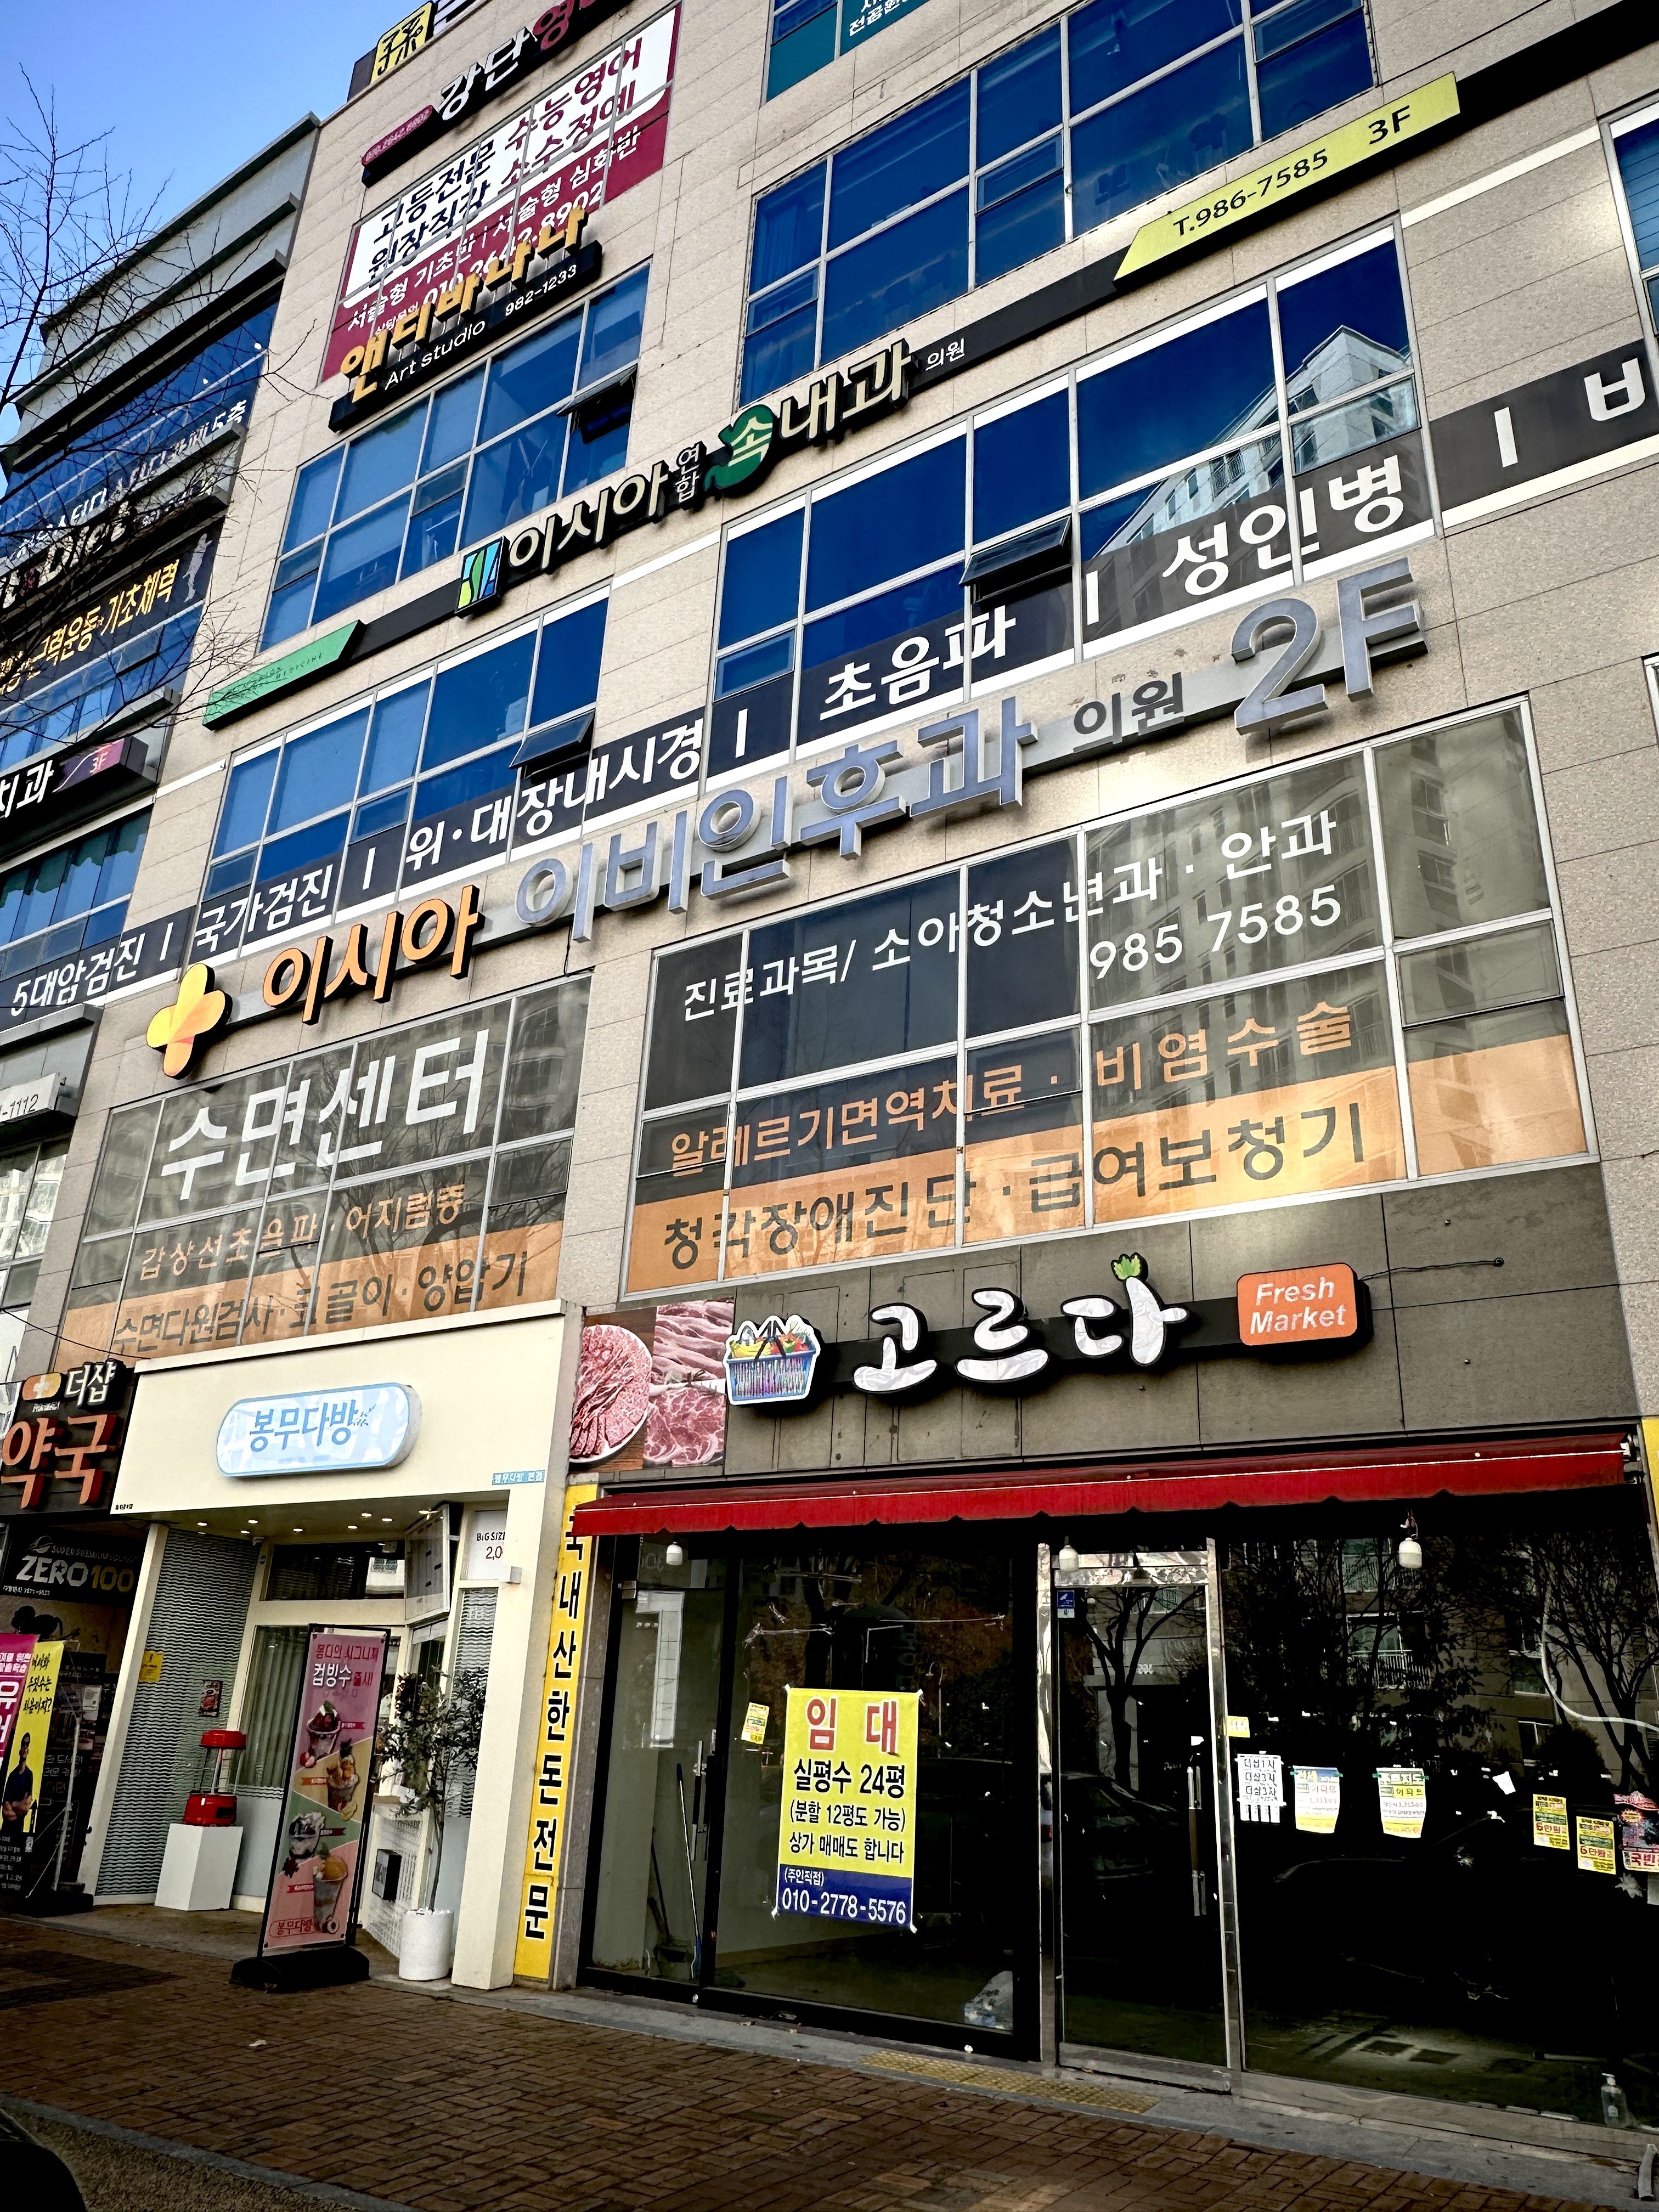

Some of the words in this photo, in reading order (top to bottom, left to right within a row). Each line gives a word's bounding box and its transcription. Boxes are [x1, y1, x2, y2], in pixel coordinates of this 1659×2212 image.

[441, 0, 597, 120] 강단영
[368, 180, 490, 287] 원장직강
[498, 80, 636, 195] 소수정예
[374, 139, 495, 243] 고등전문
[505, 37, 642, 150] 수능영어
[1173, 149, 1328, 236] T.986-7585
[1368, 105, 1410, 145] 3F
[348, 278, 408, 331] 서술형
[414, 233, 476, 287] 기초반
[493, 177, 561, 236] 서술형
[570, 125, 641, 190] 심화반
[340, 205, 585, 403] 앤디바나나
[386, 359, 415, 390] Art
[421, 321, 485, 368] studio
[505, 264, 576, 317] 982-1233
[509, 461, 668, 569] 이시아
[676, 441, 699, 503] 연합
[730, 341, 911, 467] 속내과
[927, 338, 965, 371] 의원
[100, 558, 180, 636] 기초체력
[11, 933, 145, 1016] 5대암검진
[194, 864, 334, 953] 국가검진
[820, 605, 1015, 721] 초음파
[1162, 455, 1403, 596] 성인병
[89, 752, 110, 774] 3F
[263, 885, 481, 1025] 이시아
[516, 696, 1037, 943] 이비인후과
[1073, 673, 1184, 753] 의원
[1231, 556, 1422, 735] 2F
[685, 939, 856, 1022] 진료과목/
[872, 857, 1163, 972] 소아청소년과
[1221, 810, 1336, 880] 안과
[1091, 924, 1182, 979] 985
[1207, 884, 1342, 953] 7585
[0, 1094, 38, 1119] -1112
[161, 1029, 489, 1201] 수면센터
[671, 1065, 1024, 1177] 알레르기면역치료
[1097, 1001, 1352, 1090] 비염수술
[346, 1183, 465, 1239] 어지럼증
[853, 1276, 1188, 1392] 고르다
[1249, 1304, 1347, 1338] Market
[1255, 1277, 1335, 1305] Fresh
[64, 1359, 117, 1408] 더샵
[250, 1400, 358, 1452] 봉무다방
[1, 1414, 109, 1510] 약국
[476, 1532, 489, 1541] BIG
[313, 1663, 352, 1688] 컵빙수
[790, 1799, 821, 1824] (분할
[827, 1804, 867, 1828] 12평도
[873, 1808, 906, 1833] 가능)
[794, 1758, 851, 1795] 실평수
[860, 1764, 905, 1799] 24평
[784, 1866, 825, 1887] (주인직접)
[789, 1832, 815, 1855] 상가
[820, 1835, 859, 1859] 매매도
[864, 1838, 904, 1864] 합니다
[782, 1889, 906, 1925] 010-2778-5576
